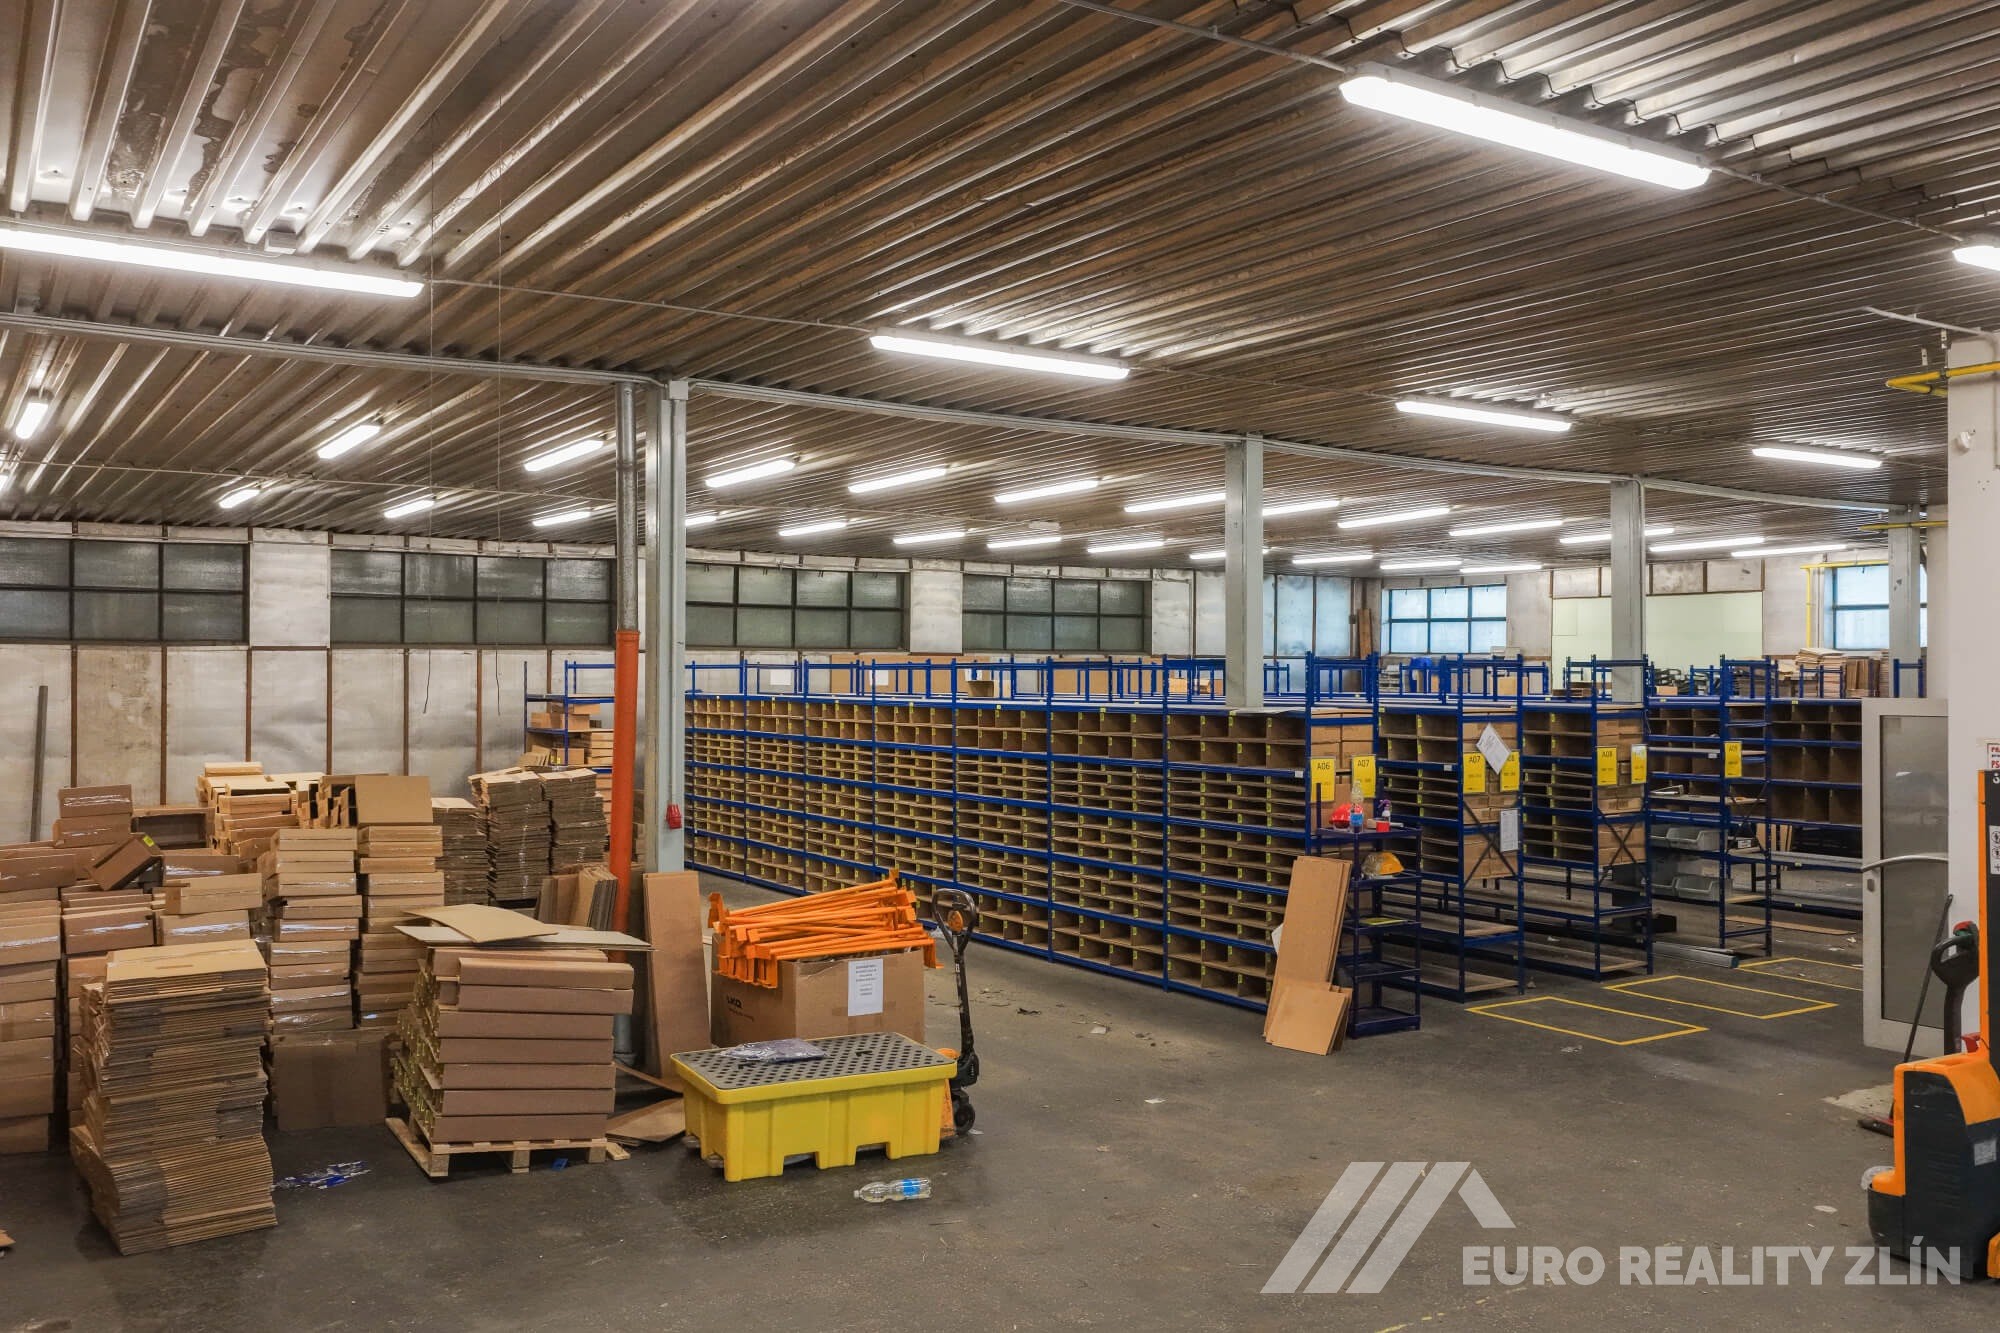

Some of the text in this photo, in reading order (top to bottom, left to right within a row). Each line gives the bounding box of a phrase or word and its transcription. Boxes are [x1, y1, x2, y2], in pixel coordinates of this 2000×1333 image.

[1357, 759, 1370, 768] A07
[1468, 755, 1481, 763] A07
[1317, 761, 1331, 770] A06
